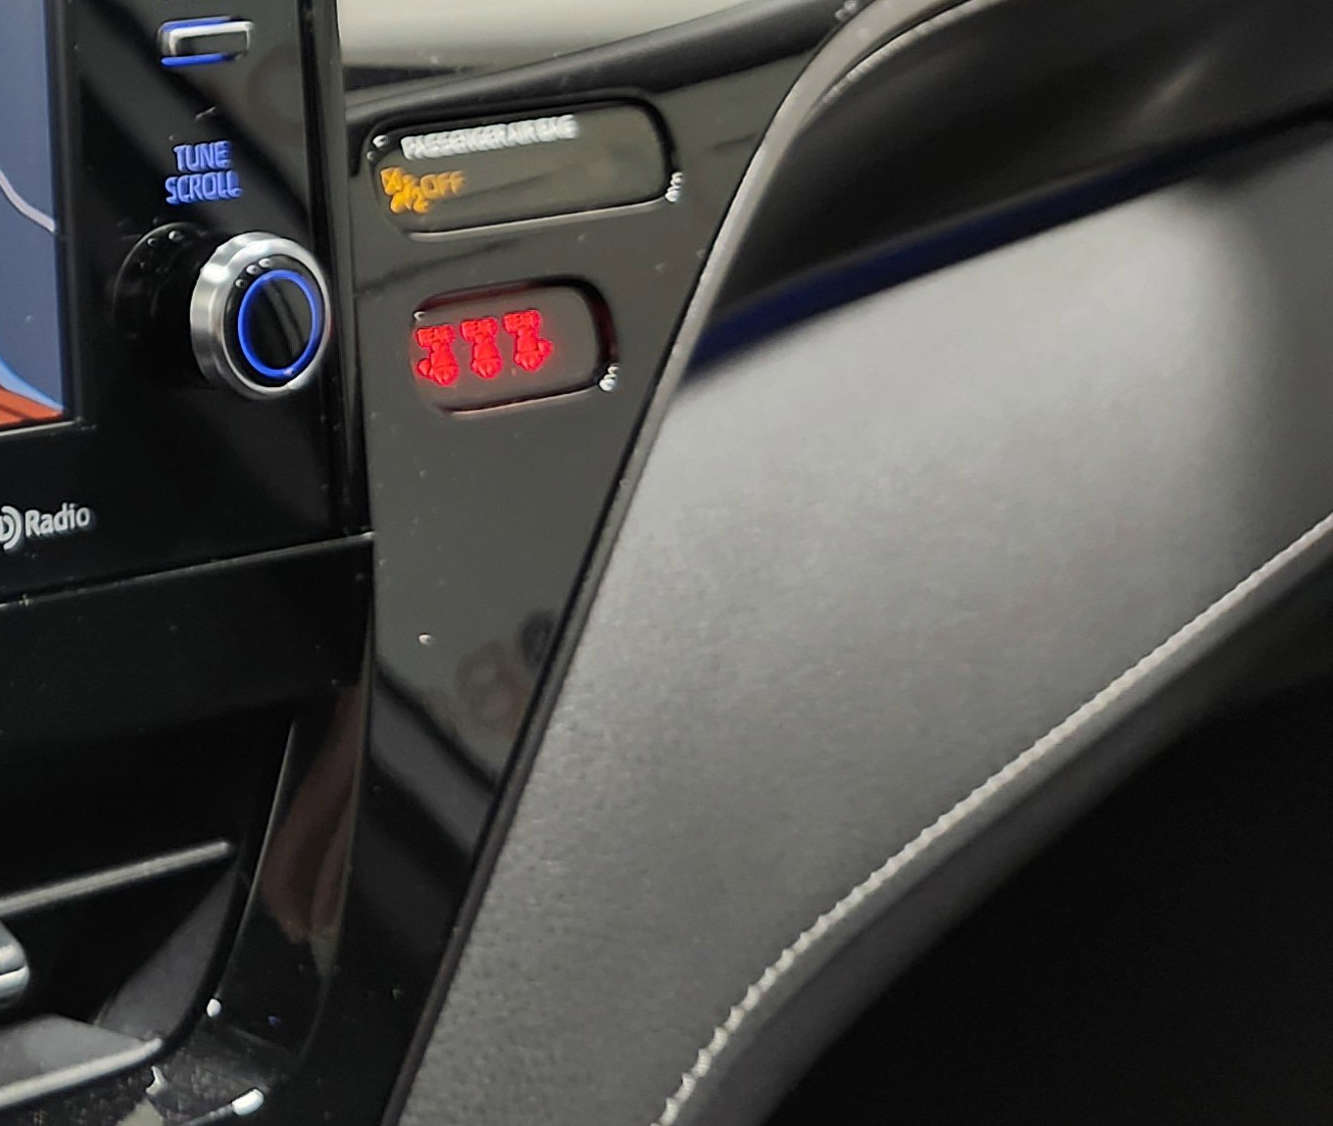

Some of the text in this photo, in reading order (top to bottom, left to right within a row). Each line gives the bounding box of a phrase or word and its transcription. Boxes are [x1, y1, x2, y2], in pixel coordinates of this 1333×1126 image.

[173, 140, 231, 173] TUNE
[164, 169, 242, 206] SCROLL
[420, 170, 465, 200] OFF
[24, 503, 91, 538] Radio
